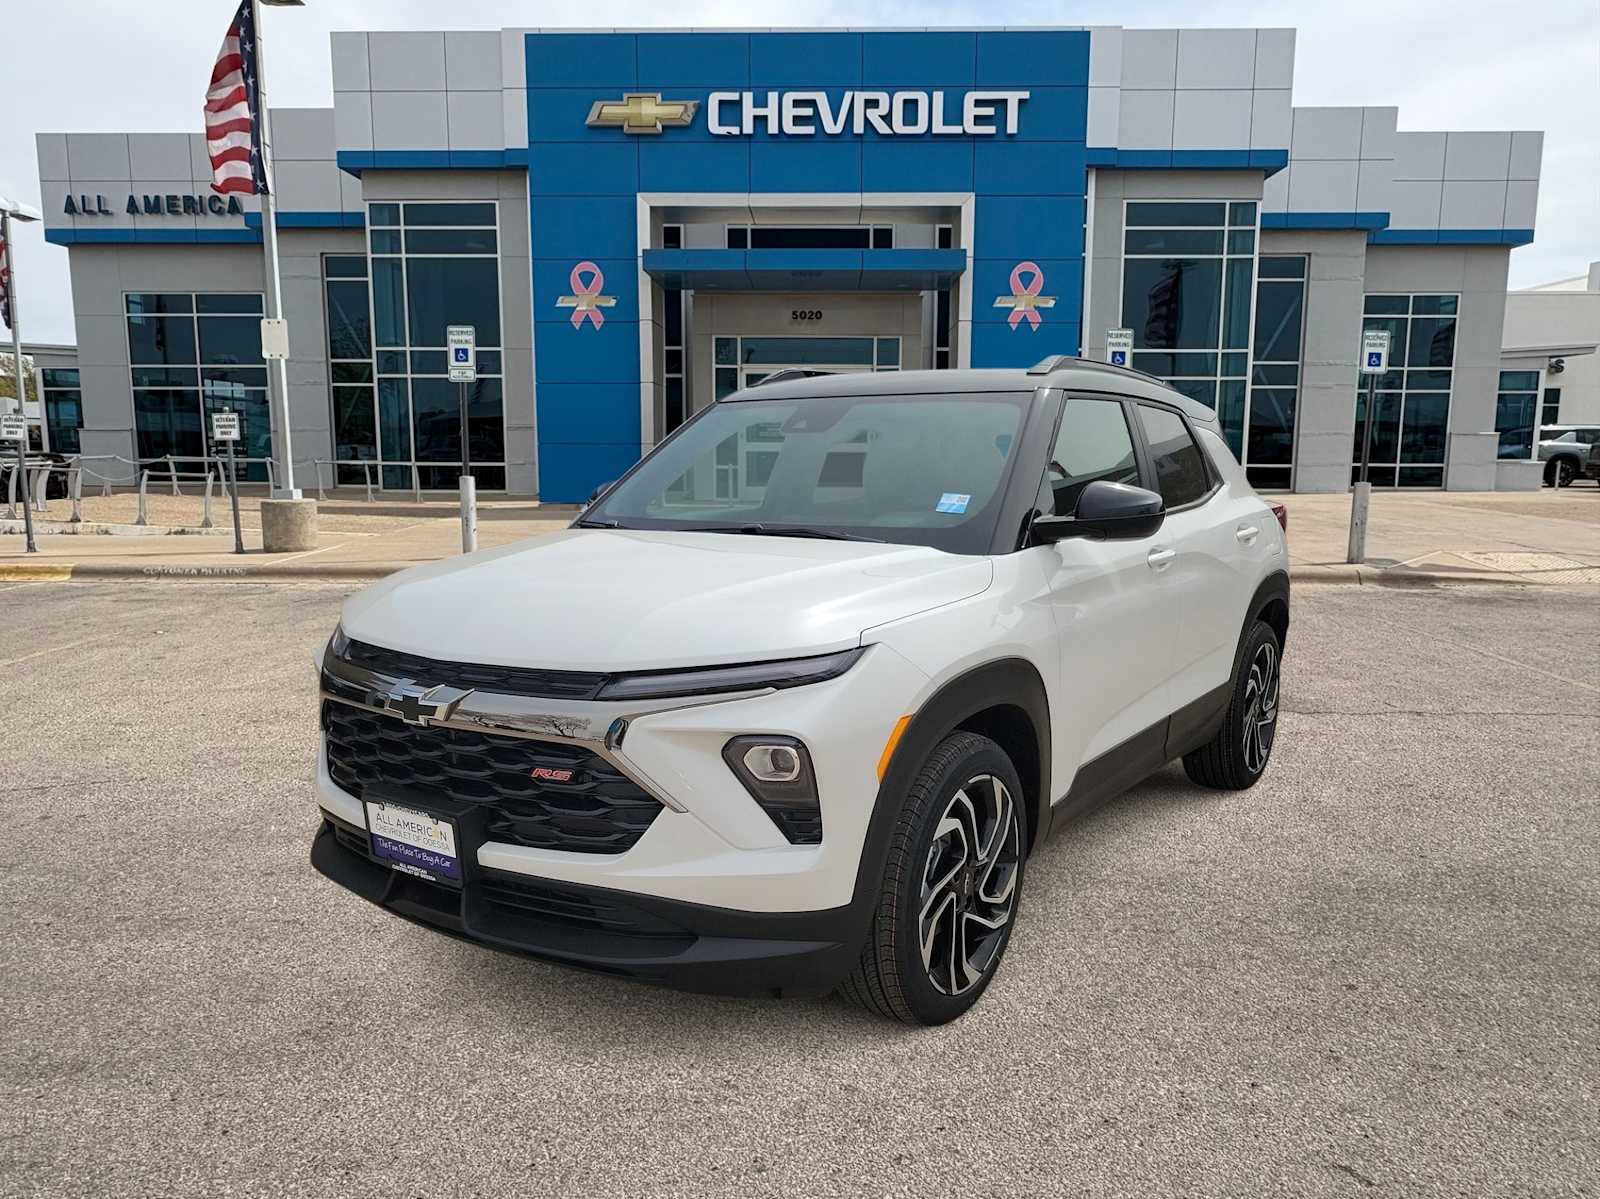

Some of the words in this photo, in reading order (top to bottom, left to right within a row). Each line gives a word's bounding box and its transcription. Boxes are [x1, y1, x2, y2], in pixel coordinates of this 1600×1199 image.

[708, 91, 1030, 135] CHEVROLET
[64, 194, 112, 215] ALL
[791, 310, 823, 320] 5020
[531, 767, 572, 781] RS
[376, 813, 393, 826] ALL
[399, 844, 414, 857] Place
[414, 849, 422, 859] To
[422, 852, 434, 866] Buy
[434, 856, 440, 865] A
[440, 858, 451, 868] Car
